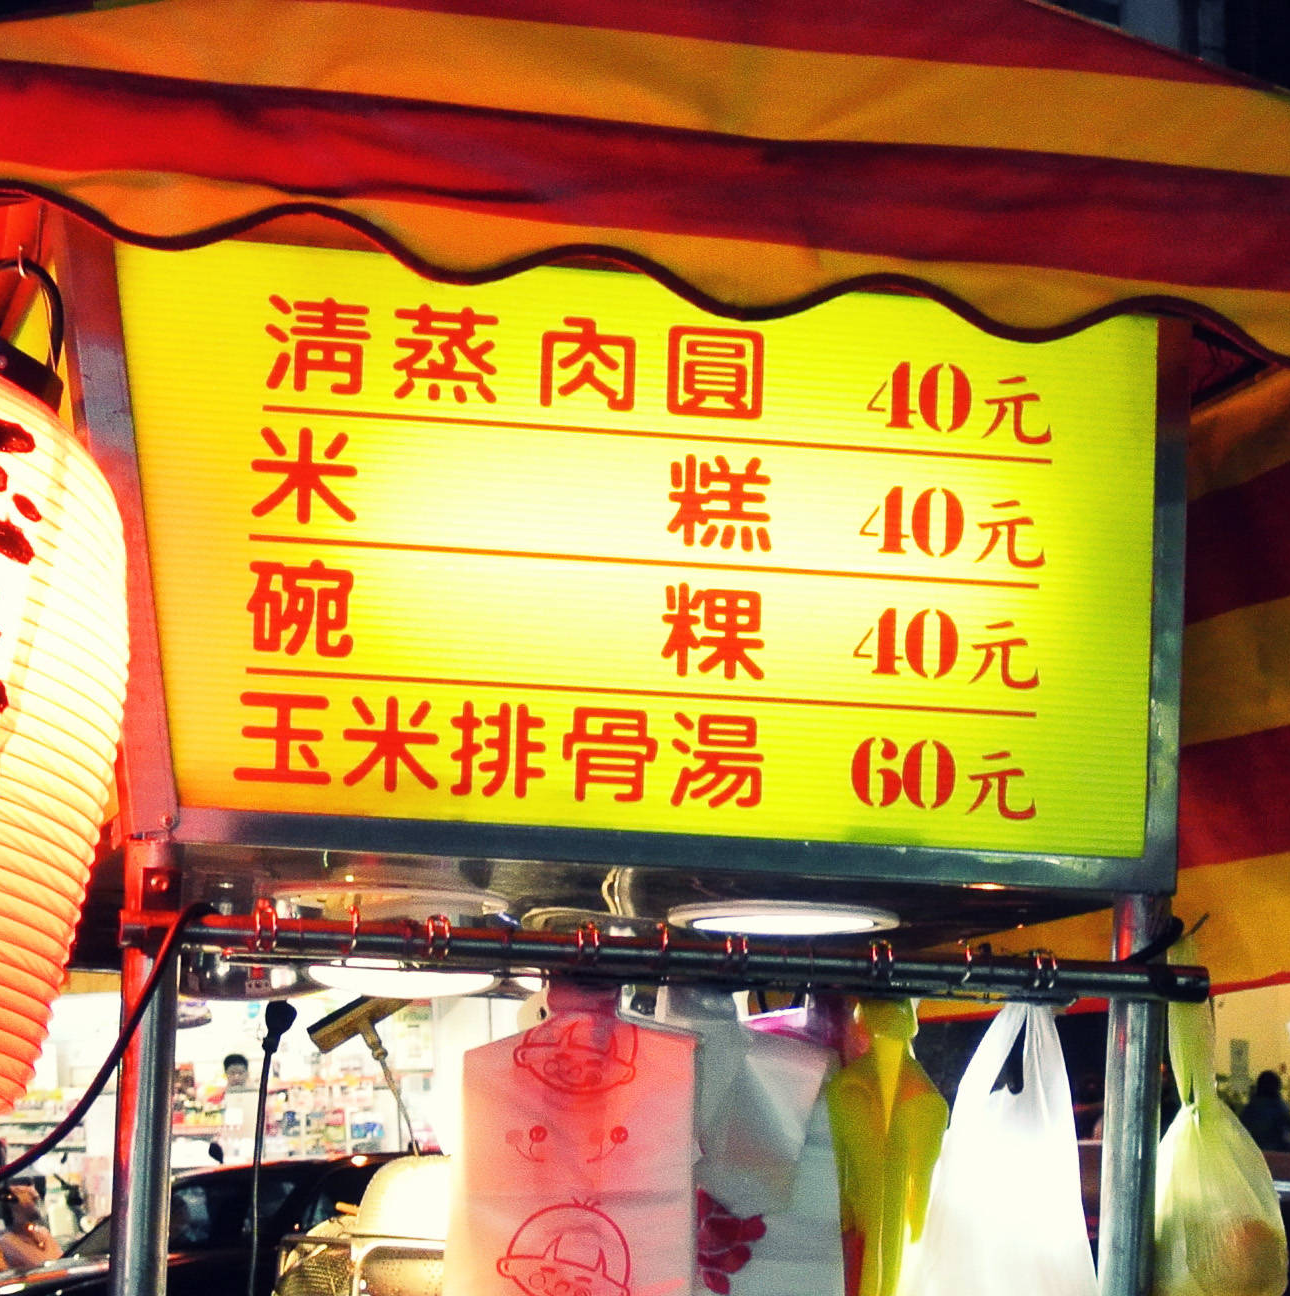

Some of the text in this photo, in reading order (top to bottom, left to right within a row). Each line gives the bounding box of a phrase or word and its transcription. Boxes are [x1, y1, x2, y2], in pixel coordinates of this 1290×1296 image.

[866, 362, 1053, 445] 40元
[859, 486, 1045, 569] 40元
[853, 607, 1041, 691] 40元
[233, 691, 1037, 821] 玉米排骨湯 60元
